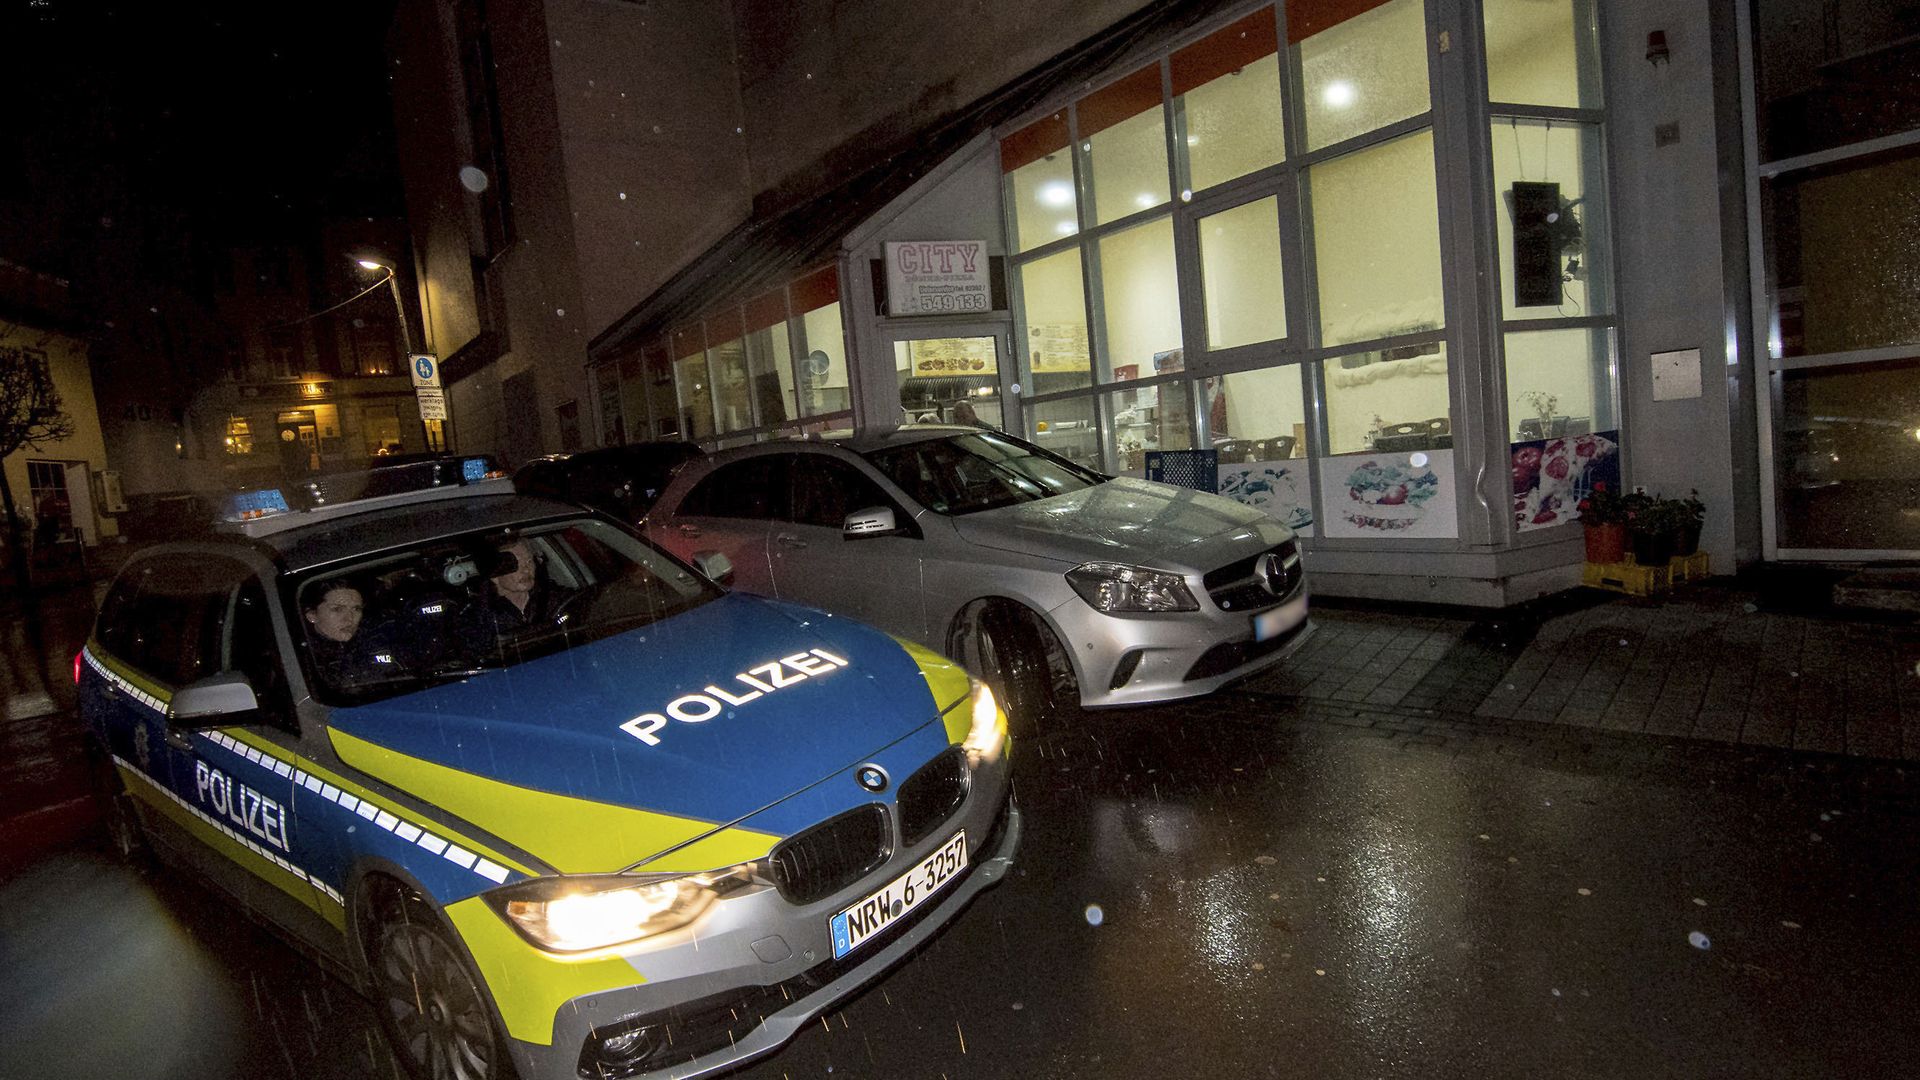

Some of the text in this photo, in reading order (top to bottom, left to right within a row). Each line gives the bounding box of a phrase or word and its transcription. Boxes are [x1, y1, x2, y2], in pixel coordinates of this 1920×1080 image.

[897, 244, 979, 273] CITY
[920, 294, 987, 311] 549 133
[422, 605, 442, 614] POLIZEI
[619, 648, 848, 746] POLIZEI
[196, 759, 290, 853] POLIZEI
[838, 836, 964, 949] D NRW 6-3257
